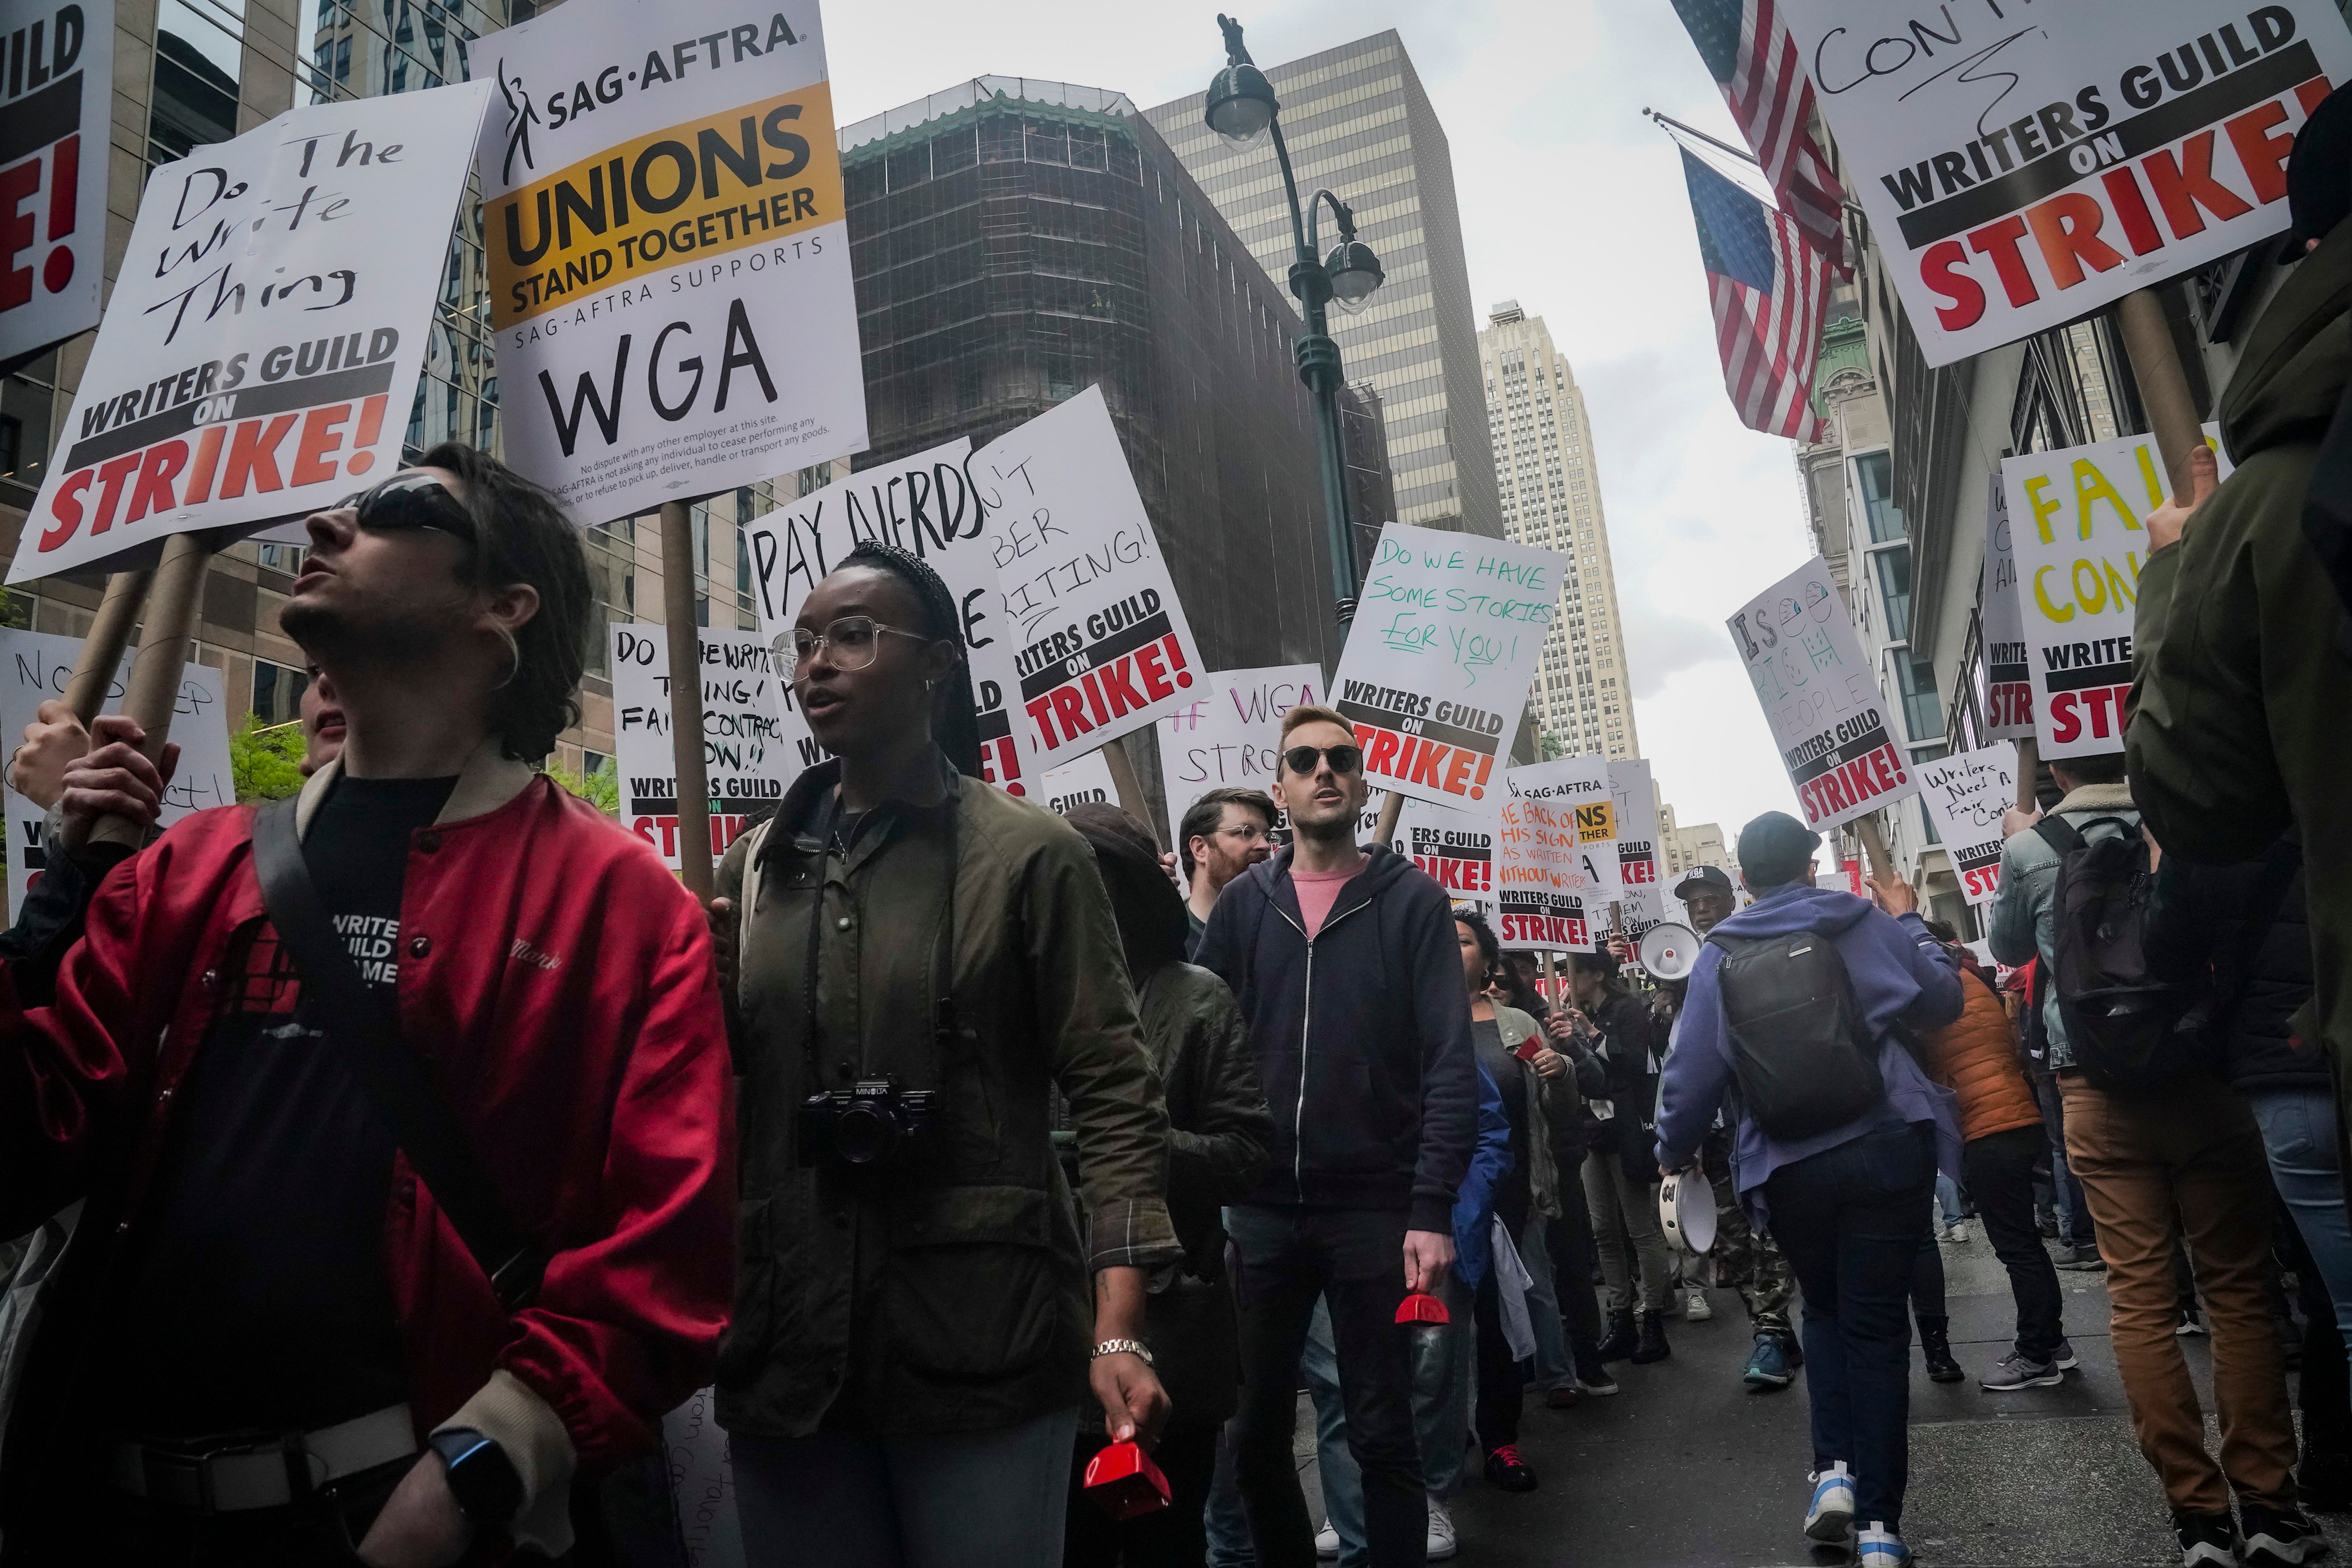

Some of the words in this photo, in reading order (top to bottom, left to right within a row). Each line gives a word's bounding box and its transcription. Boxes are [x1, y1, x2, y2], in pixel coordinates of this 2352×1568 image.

[0, 4, 84, 96] ILD
[1880, 86, 2109, 211] WRITERS
[2120, 5, 2296, 109] GUILD
[2069, 130, 2126, 176] ON
[172, 167, 249, 231] Do
[278, 129, 404, 178] The
[505, 104, 811, 266] UNIONS
[512, 249, 613, 312] STAND
[618, 187, 818, 269] TOGETHER
[142, 262, 359, 346] Thing
[515, 284, 652, 348] SAG-AFTRA
[670, 237, 823, 292] SUPPORTS
[80, 352, 250, 440] WRITERS
[260, 327, 399, 382] GUILD
[538, 298, 778, 458] WGA
[192, 394, 237, 426] ON
[594, 456, 621, 470] dispute
[622, 447, 639, 459] with
[641, 444, 655, 454] any
[657, 437, 681, 449] other
[684, 427, 727, 443] employer
[730, 424, 739, 433] at
[741, 419, 758, 430] this
[760, 415, 779, 426] site.
[598, 474, 604, 483] is
[605, 470, 618, 480] not
[619, 460, 643, 475] asking
[645, 456, 659, 466] any
[661, 443, 706, 460] individual
[709, 442, 719, 451] to
[721, 436, 746, 448] cease
[749, 422, 798, 444] performing
[800, 417, 815, 428] any
[38, 393, 389, 553] STRIKE!
[575, 494, 584, 503] or
[586, 492, 593, 500] to
[595, 484, 617, 497] refuse
[629, 473, 644, 487] pick
[646, 470, 659, 481] up,
[660, 461, 693, 476] deliver,
[695, 453, 727, 467] handle
[729, 452, 739, 460] or
[741, 439, 782, 457] transport
[785, 434, 799, 446] any
[802, 425, 830, 443] goods.
[2024, 436, 2219, 545] FAI
[753, 501, 827, 620] PAY
[845, 450, 984, 558] NERDS
[989, 508, 1069, 569] BER
[1376, 539, 1411, 566] DO
[1425, 550, 1464, 569] WE
[1477, 556, 1546, 590] HAVE
[1368, 575, 1438, 608] SOME
[1446, 588, 1553, 624] STORIES
[617, 632, 655, 665] DO
[723, 643, 770, 673] WRIT
[1015, 624, 1083, 678] RITERS
[1087, 588, 1161, 642] GUILD
[1381, 613, 1438, 647] FOR
[1450, 625, 1517, 670] YOU!
[1990, 642, 2027, 664] WRITE
[2042, 636, 2132, 670] WRITE
[1066, 652, 1091, 677] ON
[653, 676, 764, 708] TING!
[1026, 632, 1193, 755] TRIKE!
[1343, 679, 1431, 717] WRITERS
[1436, 701, 1504, 735] GUILD
[1989, 683, 2033, 728] STR
[622, 706, 670, 736] FAI
[703, 710, 783, 748] CONTRAC
[1401, 717, 1424, 735] ON
[1785, 730, 1835, 770] WRITERS
[1836, 708, 1881, 744] GUILD
[1179, 743, 1277, 782] STRO
[1353, 724, 1494, 800] TRIKE!
[1826, 751, 1842, 768] ON
[1925, 759, 1996, 789] Writers
[630, 777, 721, 797] WRIS
[726, 778, 781, 797] GUILD
[1800, 742, 1907, 824] STRIKE!
[1946, 777, 1987, 802] Need
[1999, 771, 2011, 786] A
[1523, 801, 1557, 829] BACK
[1560, 811, 1576, 829] OF
[1575, 805, 1607, 828] NS
[1945, 798, 1985, 820] Fair
[1410, 827, 1440, 843] ERS
[1445, 831, 1491, 848] GUILD
[1423, 845, 1439, 855] ON
[1535, 829, 1574, 848] SIGN
[1579, 828, 1609, 843] THER
[1584, 842, 1610, 850] PORTS
[1618, 841, 1651, 854] GUILD
[1526, 849, 1572, 864] WRITTEN
[1620, 861, 1655, 885] KE!
[1499, 889, 1549, 906] WRITERS
[1551, 894, 1583, 908] GUILD
[1550, 872, 1588, 891] WRITERS
[1964, 863, 2000, 897] ST
[333, 914, 400, 939] WRITE
[1501, 914, 1589, 946] STRIKE!
[1540, 906, 1550, 916] ON
